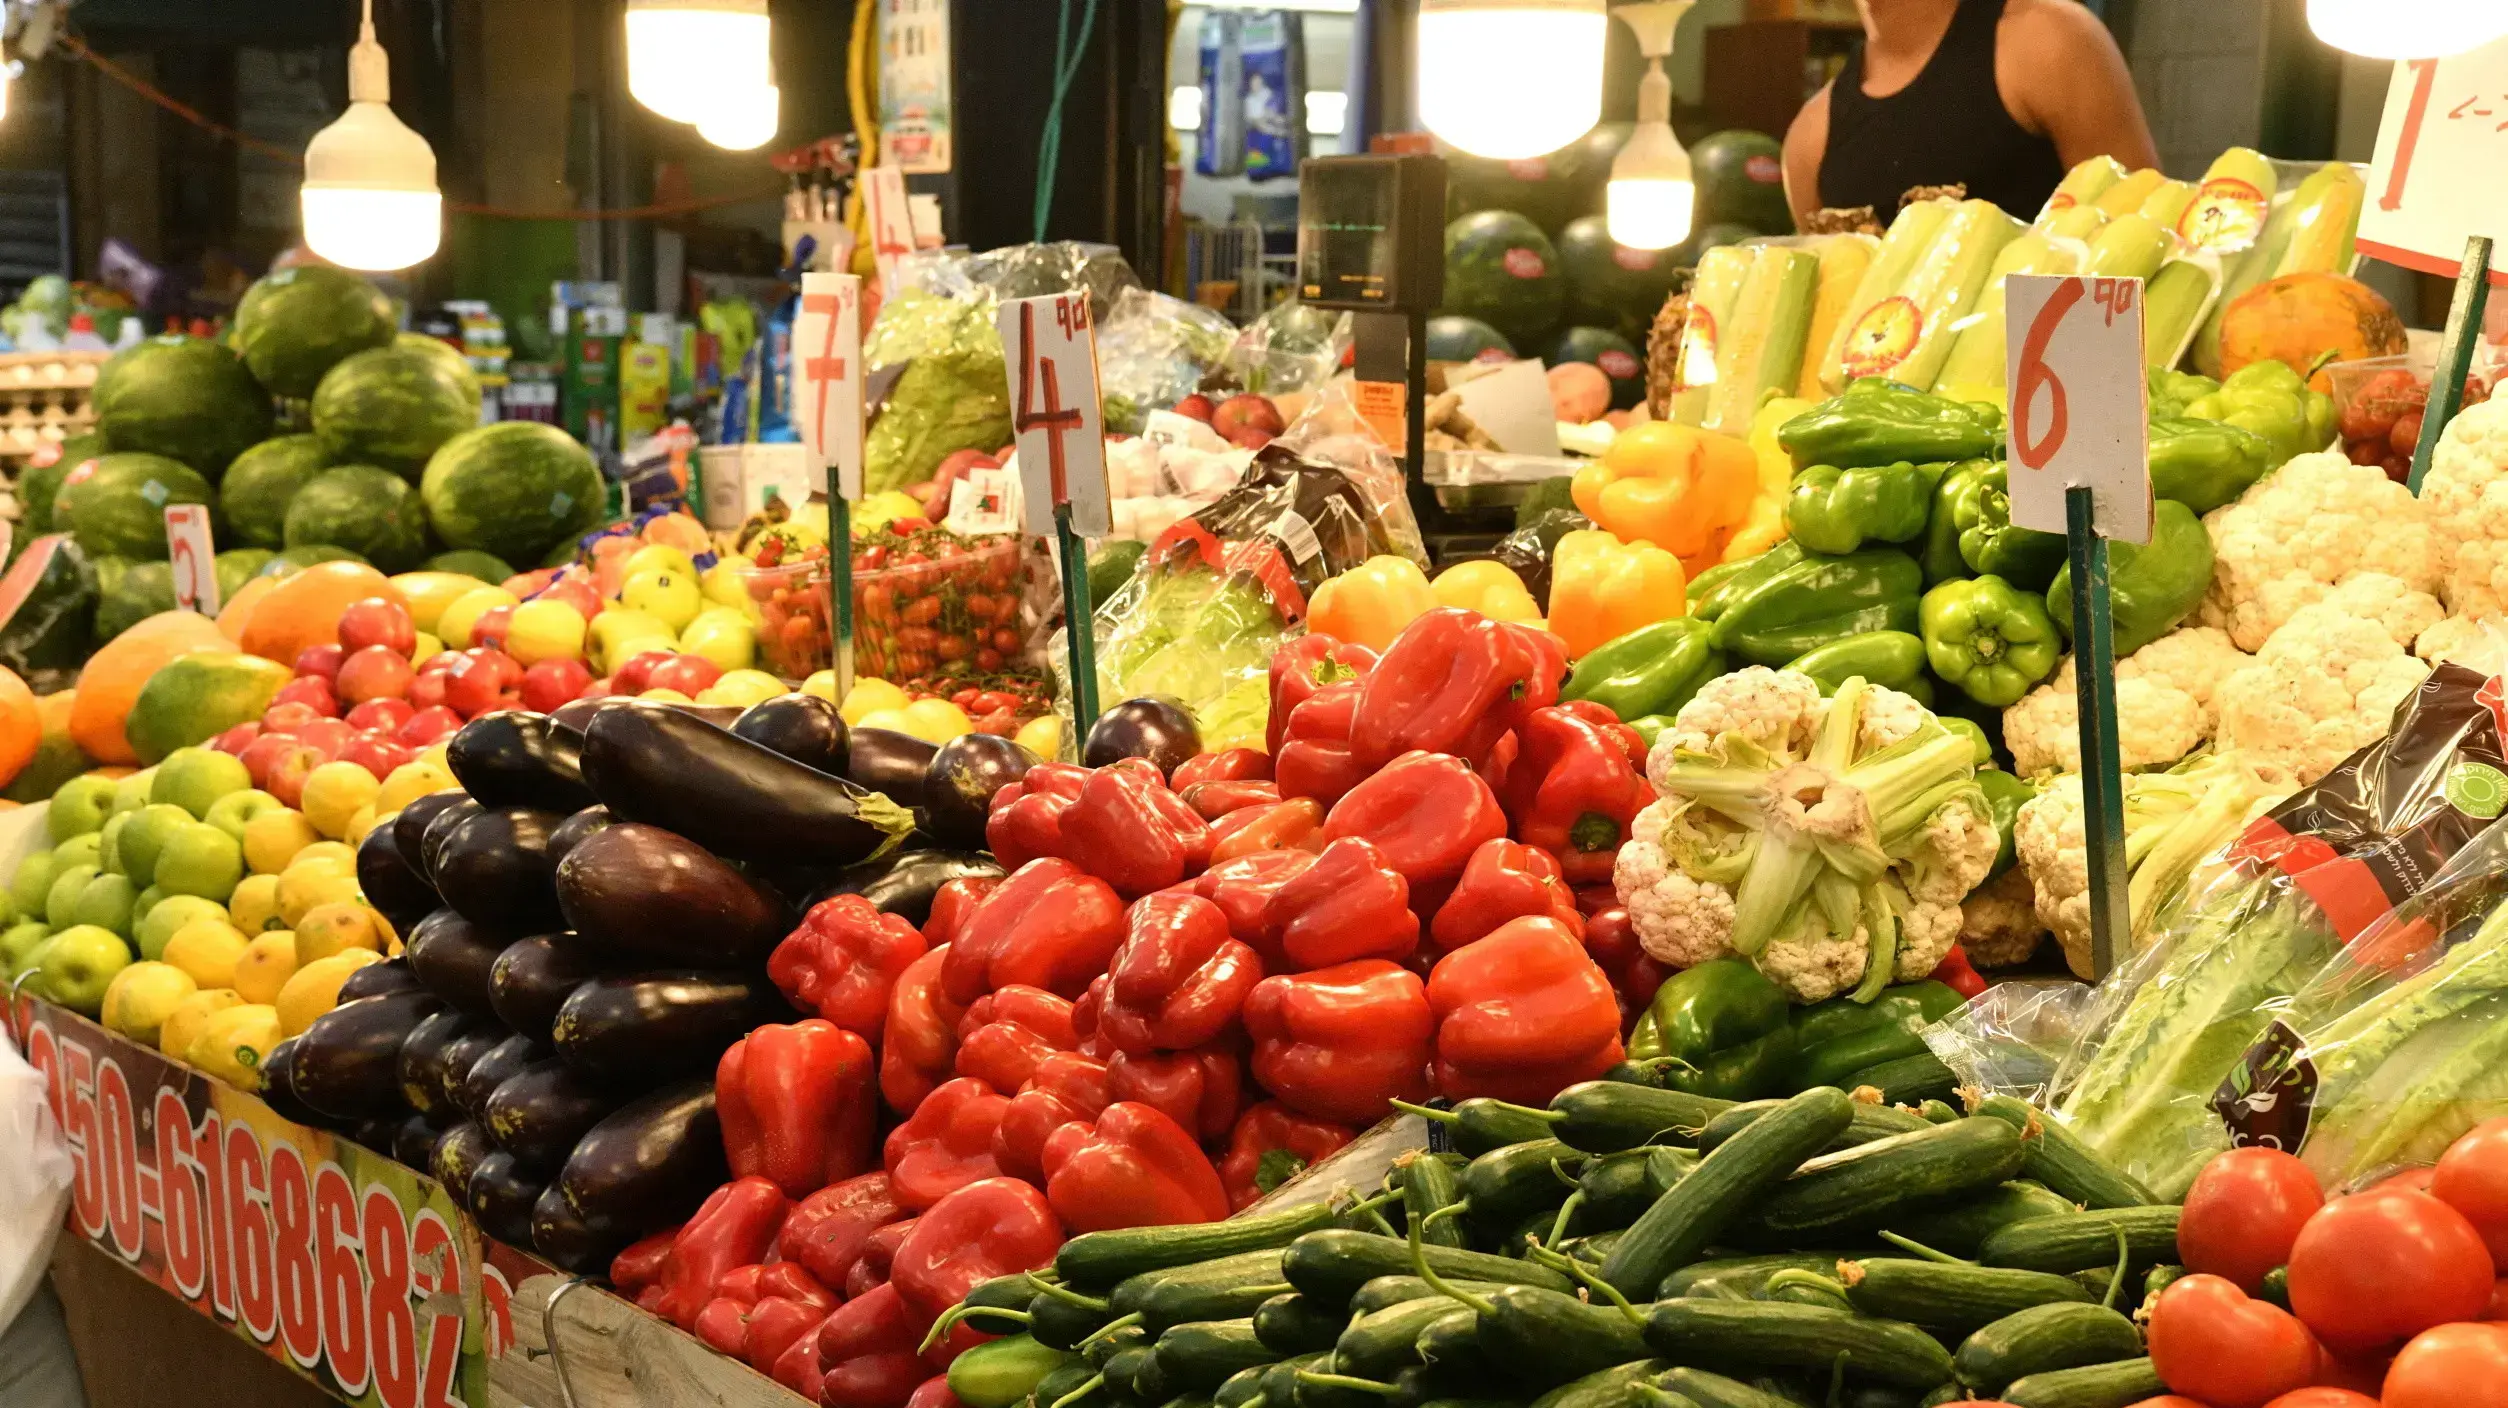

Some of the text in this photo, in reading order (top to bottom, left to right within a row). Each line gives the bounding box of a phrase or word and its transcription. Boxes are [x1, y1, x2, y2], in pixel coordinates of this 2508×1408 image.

[803, 294, 846, 456] 7
[1016, 296, 1088, 505] 4 90
[2013, 277, 2136, 471] 6 90
[168, 512, 198, 606] 5
[2402, 855, 2418, 872] ללא
